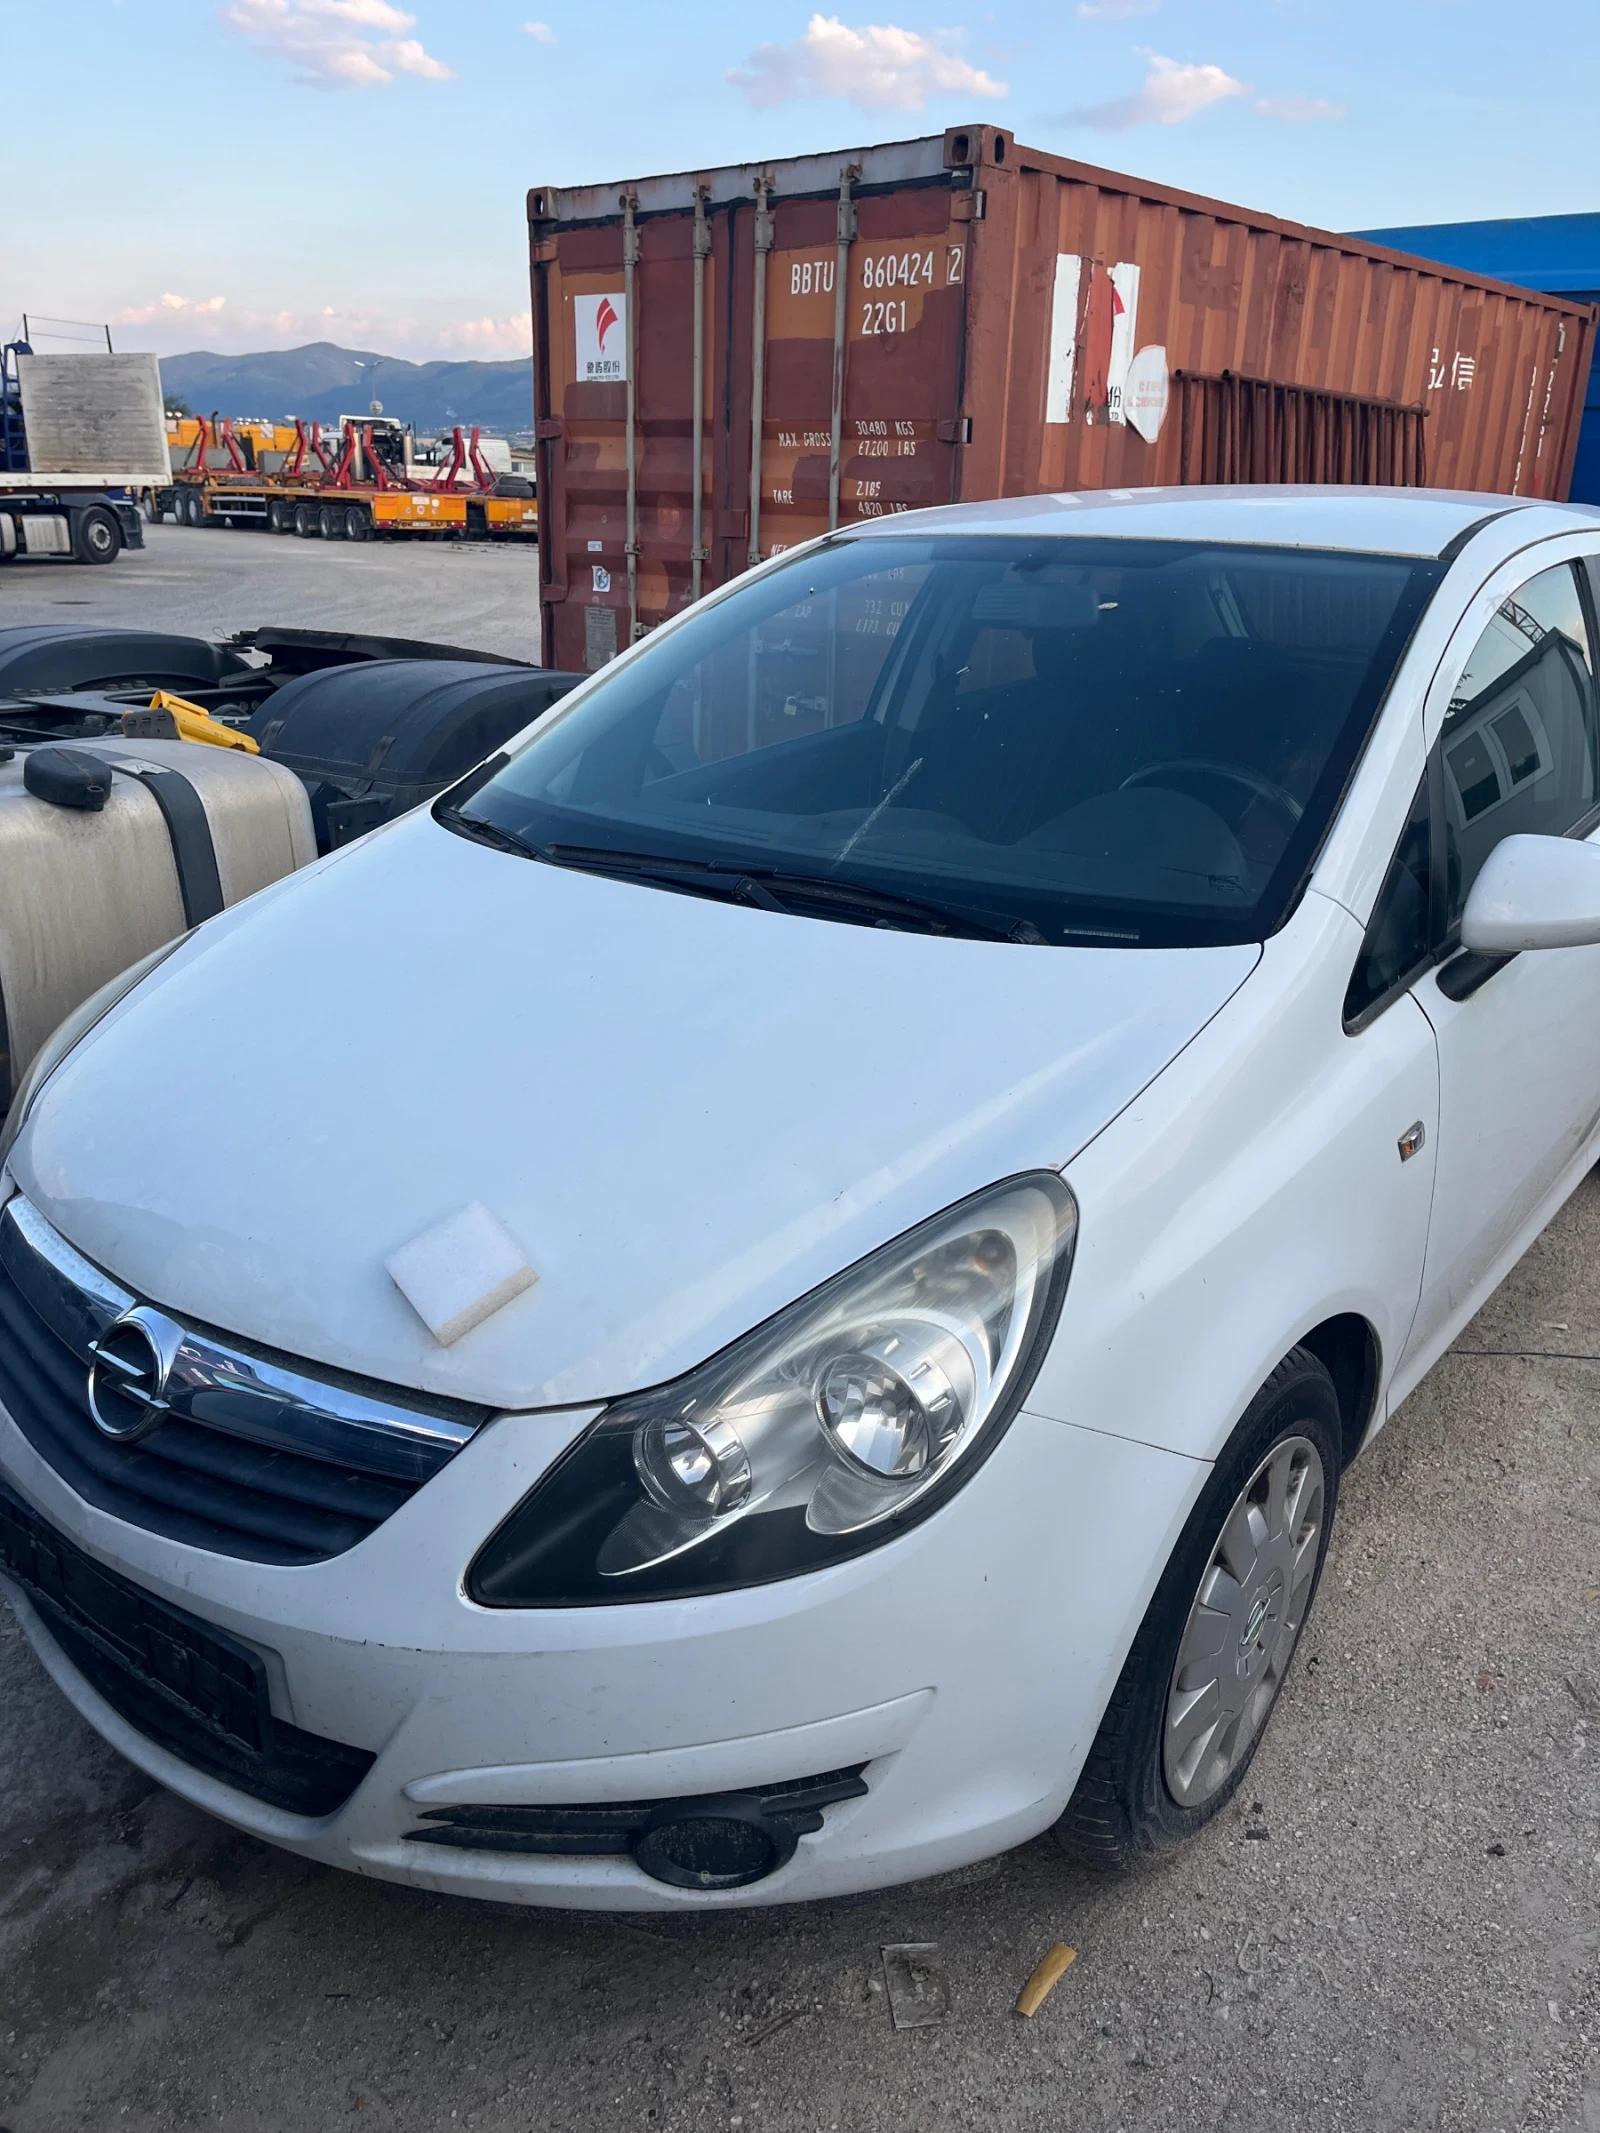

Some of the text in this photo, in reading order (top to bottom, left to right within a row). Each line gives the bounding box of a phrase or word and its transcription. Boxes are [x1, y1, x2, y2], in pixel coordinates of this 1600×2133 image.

[791, 247, 962, 294] BBTU 860424 2
[861, 300, 906, 335] 22G1
[778, 432, 801, 447] MAX.
[803, 432, 832, 447] GROSS
[894, 421, 915, 436] KGS
[897, 440, 916, 456] LBS
[773, 489, 795, 505] TARE
